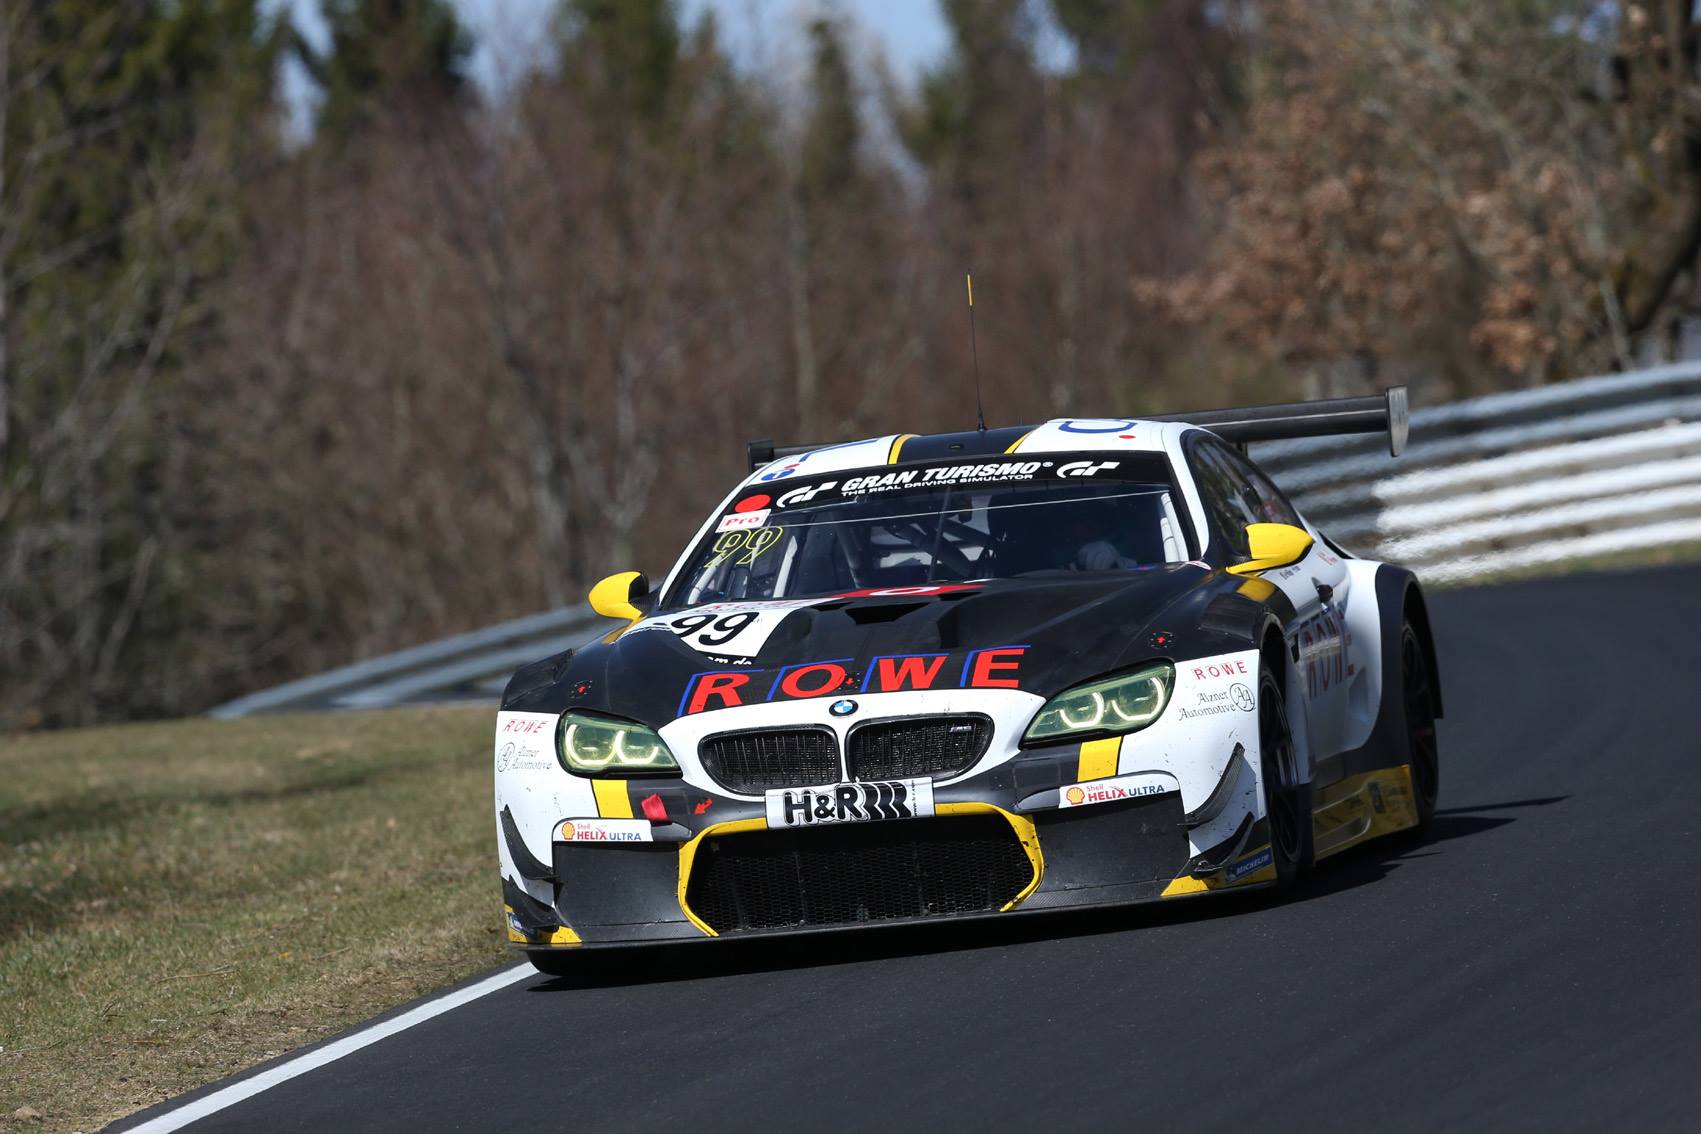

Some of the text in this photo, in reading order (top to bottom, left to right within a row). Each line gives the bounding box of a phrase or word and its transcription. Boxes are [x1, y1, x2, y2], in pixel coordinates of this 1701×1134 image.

[841, 470, 918, 492] GRAN
[841, 474, 1033, 497] THE REAL DRIVING SIMULATOR
[725, 516, 760, 527] Pro
[704, 526, 784, 568] 99
[671, 612, 760, 646] 99
[1193, 660, 1247, 681] ROWE
[687, 648, 1025, 715] ROWE
[1197, 690, 1229, 706] Alzner
[1178, 702, 1236, 721] Automotive
[504, 719, 548, 734] ROWE
[1087, 783, 1104, 792] Shell
[1088, 784, 1165, 802] HELIX ULTRA
[784, 784, 864, 825] H&R
[577, 830, 642, 841] HELIX ULTRA
